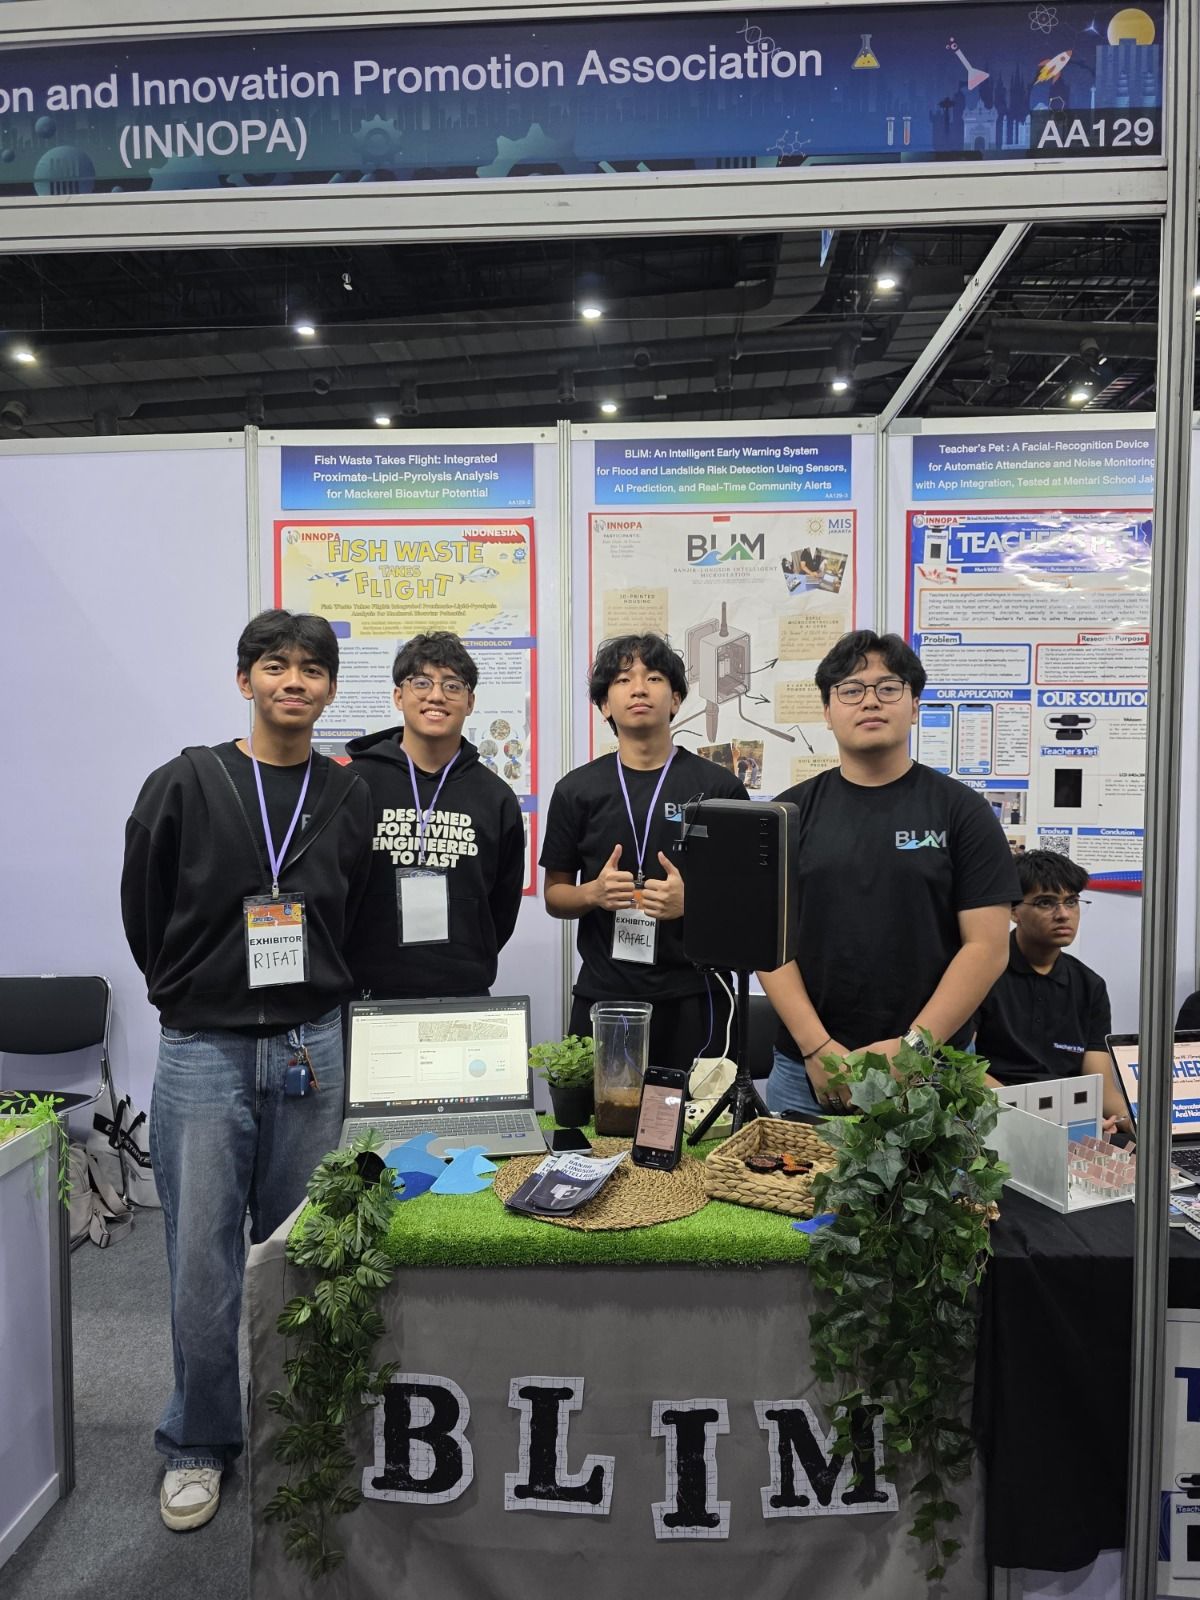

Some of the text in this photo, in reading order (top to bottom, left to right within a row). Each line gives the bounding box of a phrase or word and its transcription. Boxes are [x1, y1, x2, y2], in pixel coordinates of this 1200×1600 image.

[0, 44, 822, 114] on and Innovation Promotion Association
[1037, 117, 1155, 150] AA129
[118, 116, 308, 169] (INNOPA)
[654, 450, 666, 458] An
[669, 449, 714, 460] Intelligent
[717, 448, 739, 459] Early
[743, 448, 780, 458] Warning
[783, 447, 818, 457] System
[939, 444, 985, 454] Teacher's
[989, 445, 1004, 453] Pet
[1022, 441, 1113, 453] Facial-Recognition
[1116, 440, 1149, 449] Device
[315, 454, 497, 466] Fish Waste Takes Flight: Integrated
[929, 463, 942, 472] for
[944, 462, 993, 472] Automatic
[996, 461, 1050, 470] Attendance
[1053, 460, 1071, 468] and
[1074, 459, 1101, 468] Noise
[597, 463, 847, 476] for Flood and Landslide Risk Detection Using Sensors,
[314, 471, 499, 484] Proximate-Lipid-Pyrolysis Analysis
[916, 480, 935, 490] with
[938, 480, 958, 490] App
[961, 479, 1014, 489] Integration,
[1017, 477, 1049, 487] Tested
[1053, 478, 1061, 486] at
[1064, 476, 1100, 485] Mentari
[1103, 475, 1136, 484] School
[327, 488, 488, 498] for Mackerel Bioavtur Potential
[627, 484, 676, 494] Prediction,
[679, 484, 696, 492] and
[699, 482, 746, 492] Real-Time
[749, 482, 801, 492] Community
[804, 481, 832, 490] Alerts
[607, 522, 642, 530] INNOPA
[828, 518, 852, 529] MIS
[301, 533, 341, 541] INNOPA
[461, 529, 517, 537] INDONESIA
[328, 539, 484, 563] FISH WASTE
[379, 565, 421, 577] TAKES
[355, 572, 453, 600] FLIGHT
[924, 636, 958, 644] Problem
[1116, 635, 1144, 643] Purpose
[937, 690, 1013, 699] OUR APPLICATION
[1043, 692, 1079, 706] OUR
[1043, 747, 1098, 755] Teacher's Pet
[377, 822, 411, 836] FOR
[372, 837, 478, 856] ENGINEERED
[390, 851, 414, 865] TO
[616, 916, 656, 927] EXHIBITOR
[249, 936, 302, 946] EXHIBITOR
[618, 930, 652, 948] RAFAEL
[254, 949, 299, 969] RIFAT
[371, 1381, 890, 1528] BLIM
